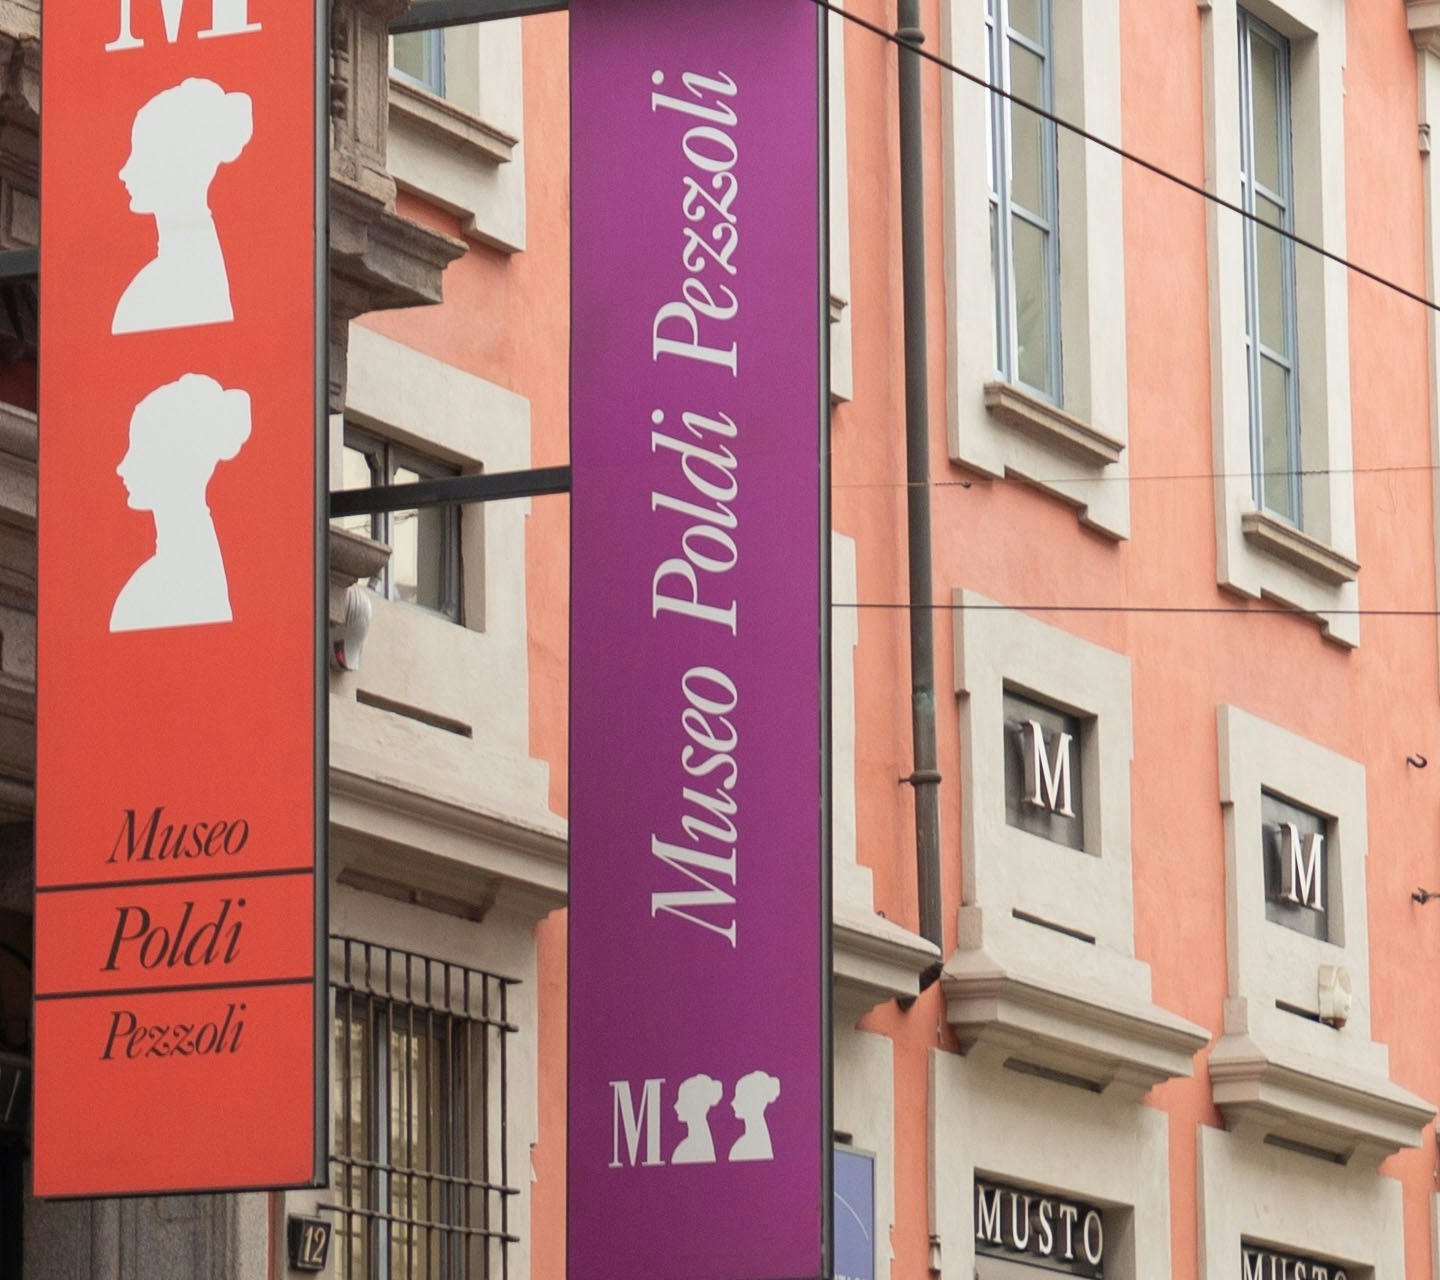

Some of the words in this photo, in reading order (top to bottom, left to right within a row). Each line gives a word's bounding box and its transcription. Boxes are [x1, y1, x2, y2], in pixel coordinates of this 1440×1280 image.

[651, 69, 741, 378] Pezzoli
[652, 408, 740, 637] Poldi
[652, 666, 740, 949] Museo
[1028, 720, 1076, 819] M
[105, 806, 250, 865] Museo
[1280, 822, 1325, 912] M
[99, 897, 247, 973] Poldi
[98, 1003, 248, 1062] Pezzoli
[608, 1078, 668, 1171] M
[303, 1225, 327, 1263] 12
[975, 1183, 1104, 1265] MUSTO
